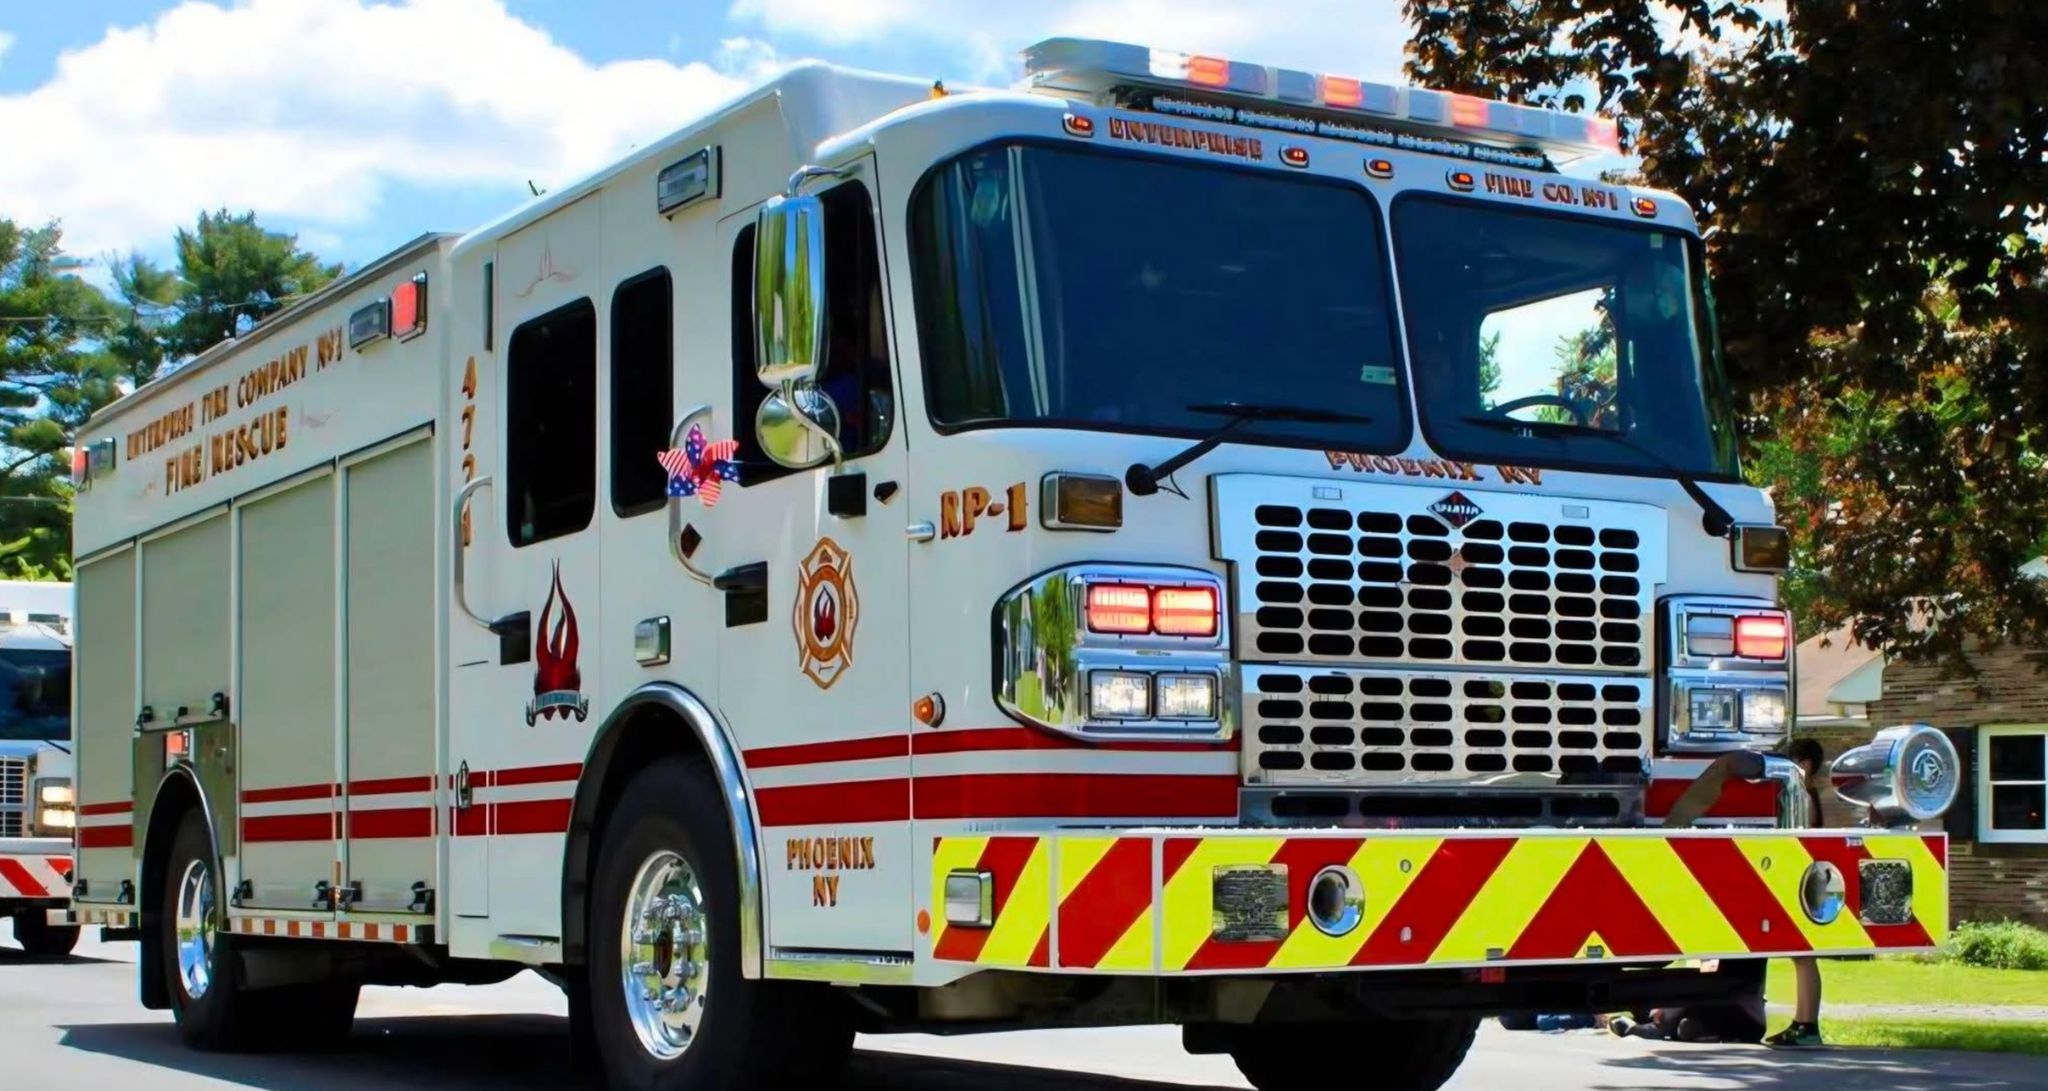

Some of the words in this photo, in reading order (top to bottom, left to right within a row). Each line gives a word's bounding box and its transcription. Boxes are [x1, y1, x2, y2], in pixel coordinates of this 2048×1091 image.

[237, 344, 309, 409] COMPANY
[1325, 450, 1484, 482] PHOENIX
[941, 481, 1028, 540] RP-1
[787, 837, 875, 870] PHOENIX
[813, 875, 840, 907] NY
